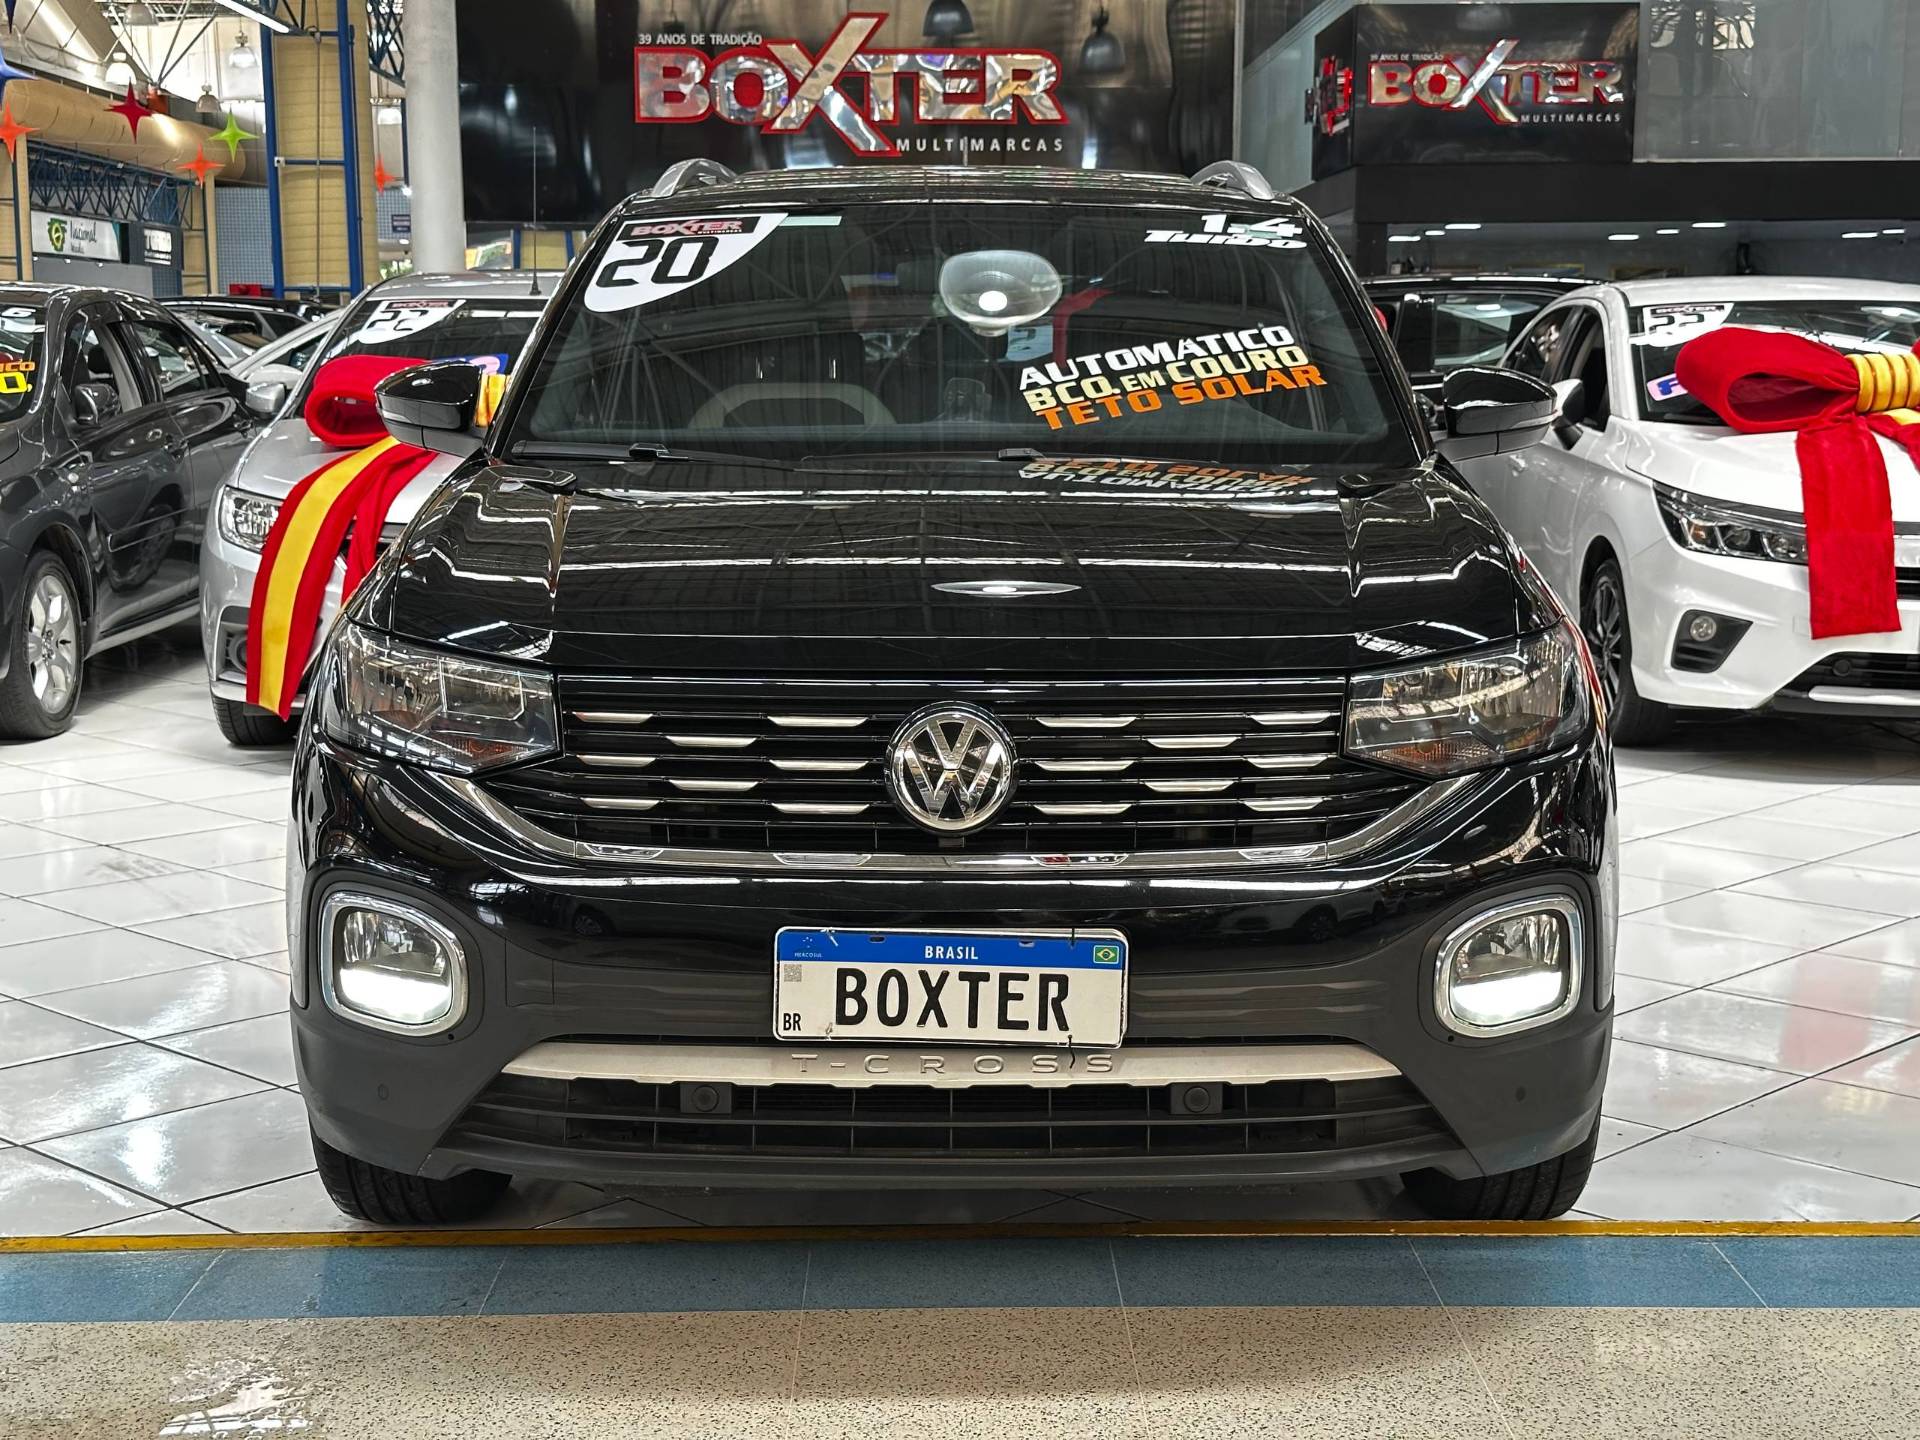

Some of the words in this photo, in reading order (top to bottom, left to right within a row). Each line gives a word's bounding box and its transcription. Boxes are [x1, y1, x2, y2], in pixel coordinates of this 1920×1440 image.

[638, 34, 651, 45] 39
[656, 34, 686, 45] ANOS
[691, 34, 705, 45] DE
[709, 32, 762, 46] TRADIÇÃO
[635, 12, 1070, 157] BOXTER
[1367, 38, 1625, 124] BOXTER
[1521, 113, 1621, 123] MULTIMARCAS
[896, 138, 1063, 152] MULTIMARCAS
[631, 219, 744, 237] BOXTER
[596, 236, 720, 287] 20
[1119, 370, 1167, 392] EM
[1165, 346, 1310, 383] COURO
[1035, 389, 1162, 430] TETO
[1172, 365, 1328, 405] SOLAR
[924, 945, 978, 960] BRASIL
[836, 967, 1070, 1032] BOXTER
[783, 1012, 802, 1031] BR
[791, 1053, 1114, 1075] T-CROSS
